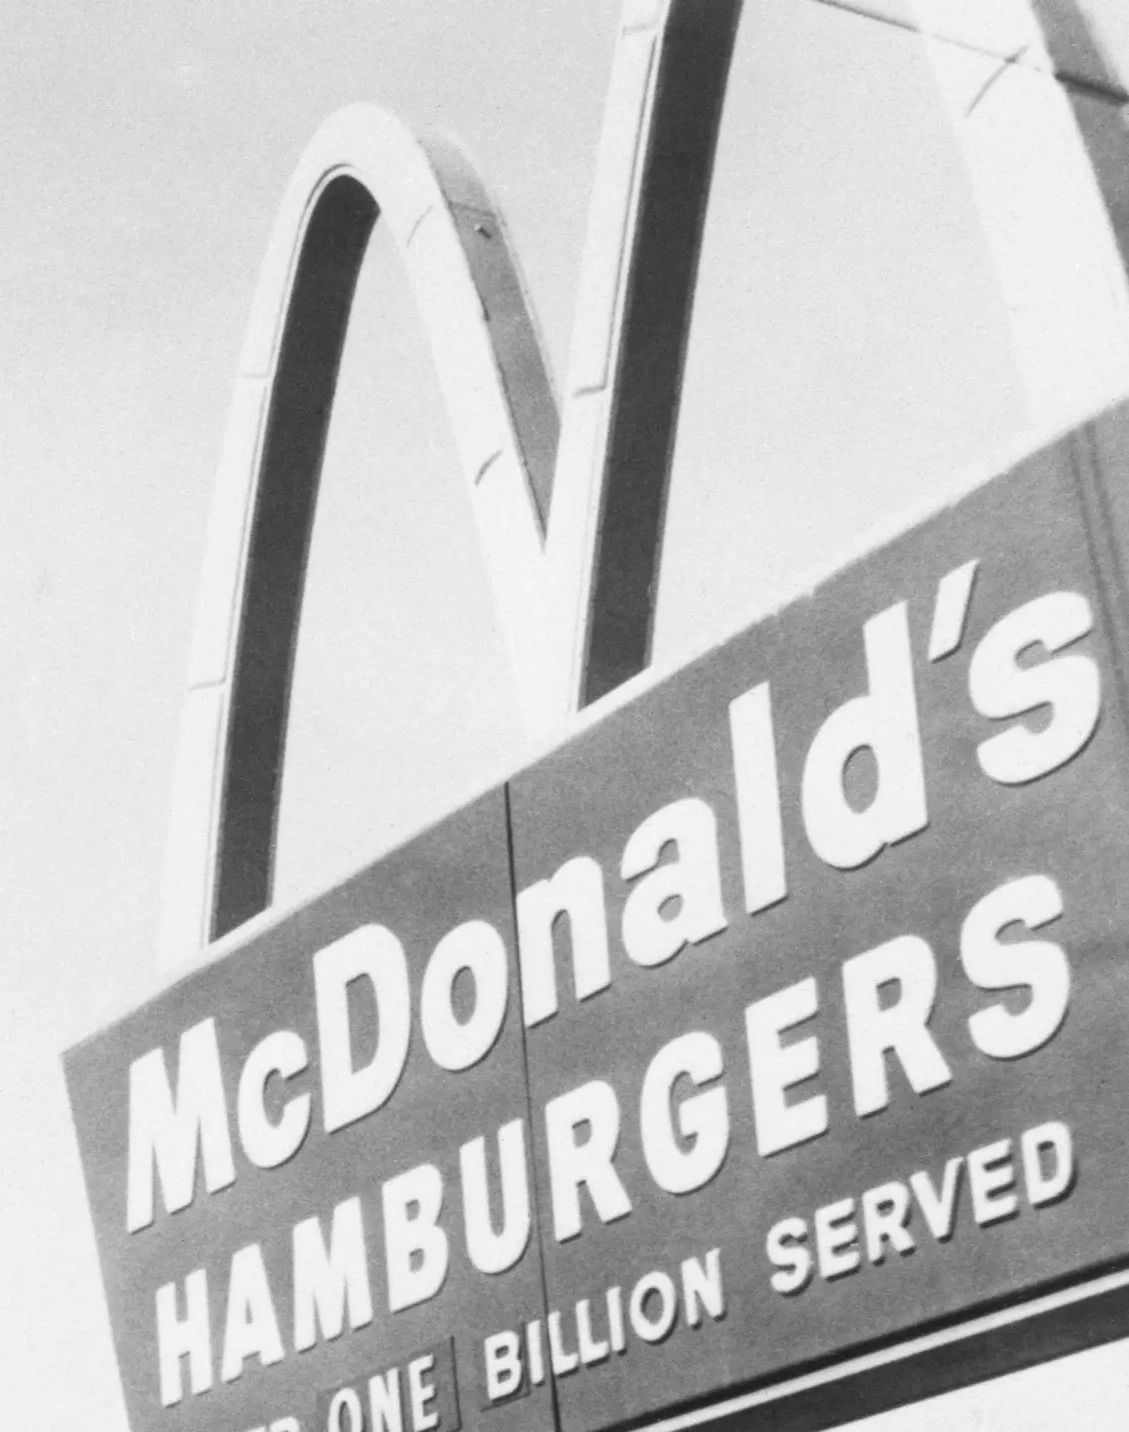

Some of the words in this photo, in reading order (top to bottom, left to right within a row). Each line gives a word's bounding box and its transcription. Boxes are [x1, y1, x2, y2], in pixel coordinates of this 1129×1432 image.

[126, 559, 1101, 1233] McDonald's
[156, 874, 1071, 1407] HAMBURGERS
[484, 1248, 723, 1400] BILLION
[766, 1122, 1072, 1292] SERVED
